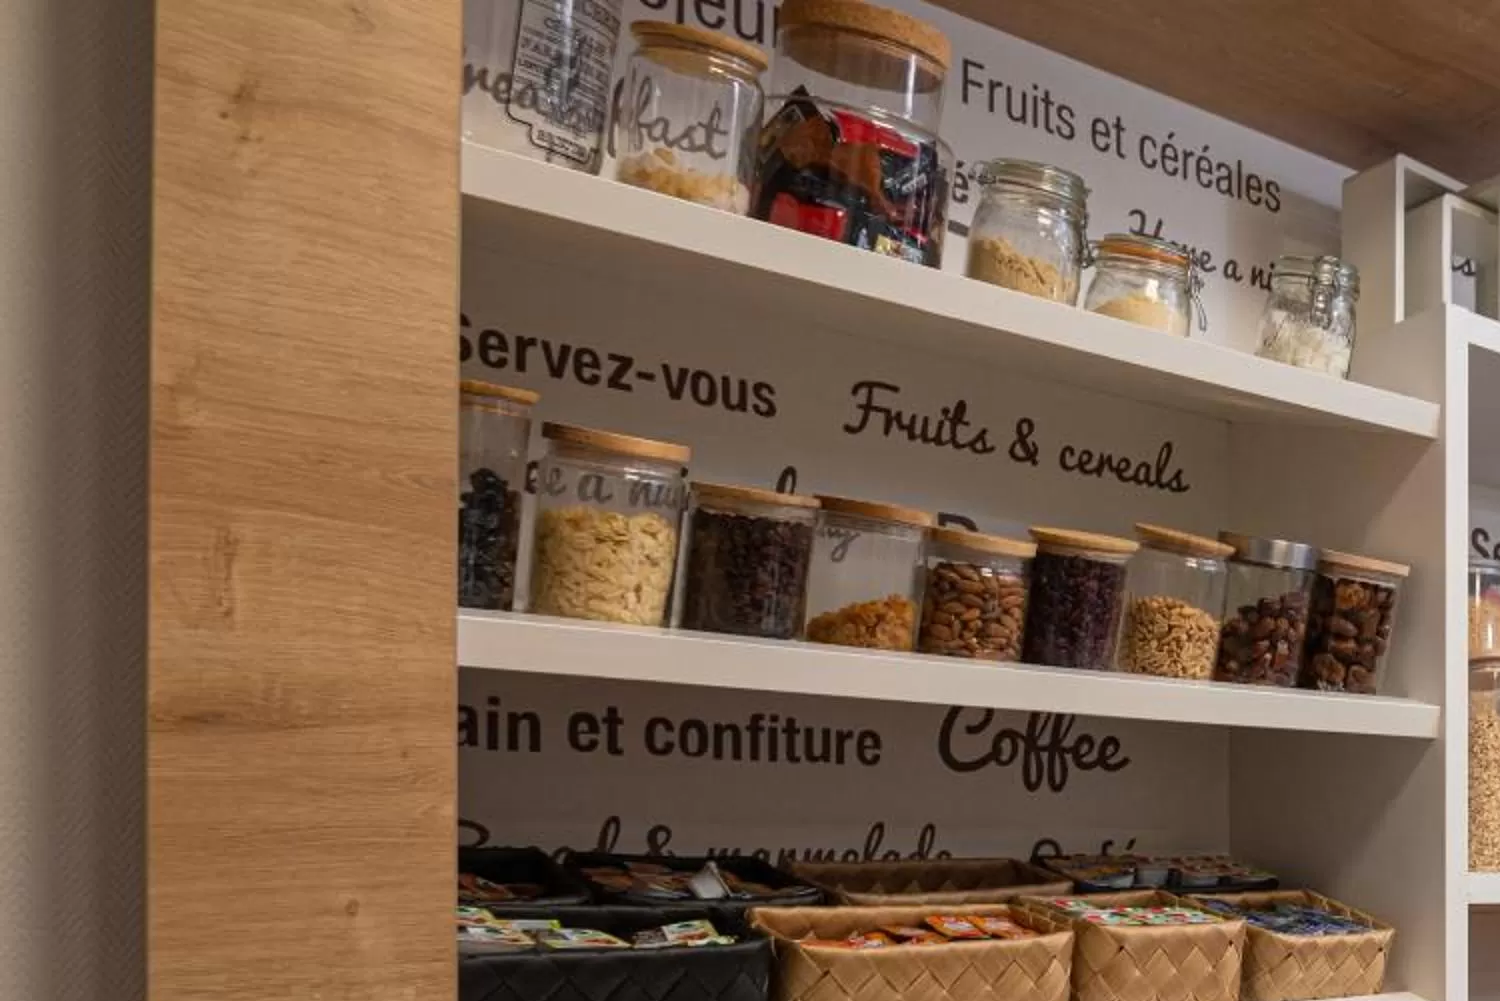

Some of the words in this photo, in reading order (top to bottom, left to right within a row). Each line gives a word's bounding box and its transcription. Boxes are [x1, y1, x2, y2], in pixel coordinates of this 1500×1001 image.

[962, 58, 1076, 141] Fruits
[1090, 115, 1127, 160] et
[1138, 130, 1282, 214] céréales
[1251, 262, 1275, 292] ni
[843, 380, 996, 454] Fruits
[1008, 417, 1040, 467] &
[1059, 441, 1191, 493] cereals
[458, 695, 542, 753] ain
[567, 705, 624, 756] et
[644, 712, 882, 766] confiture
[938, 704, 1132, 793] Coffee
